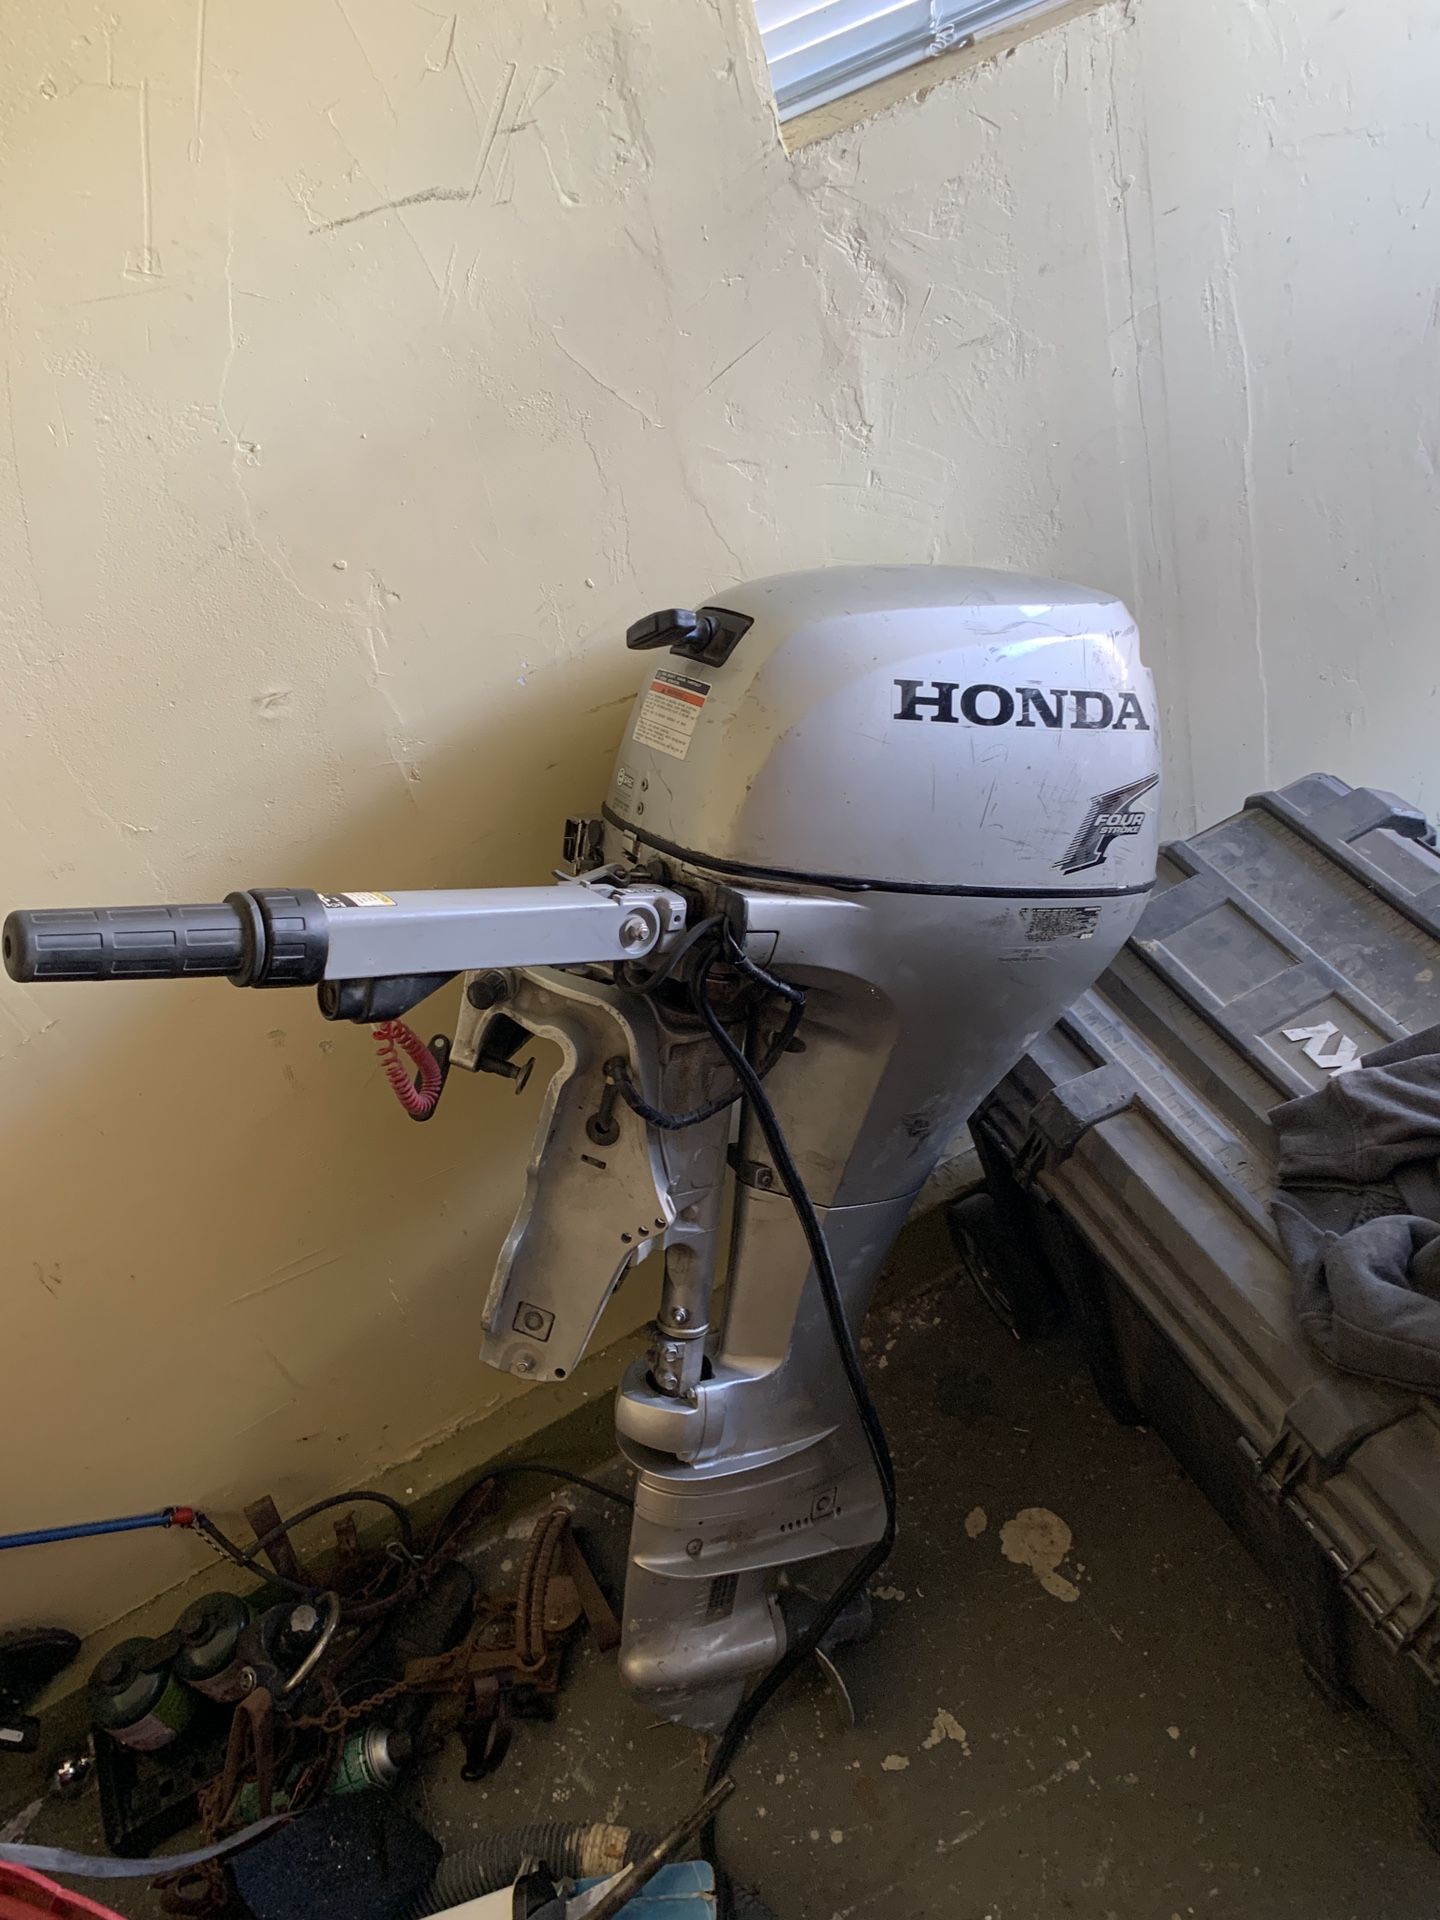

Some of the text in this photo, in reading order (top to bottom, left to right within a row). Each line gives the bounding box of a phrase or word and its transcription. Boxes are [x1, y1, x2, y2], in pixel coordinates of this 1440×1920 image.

[893, 679, 1151, 731] HONDA
[1094, 813, 1145, 826] FOUR
[1099, 826, 1140, 834] STROKE
